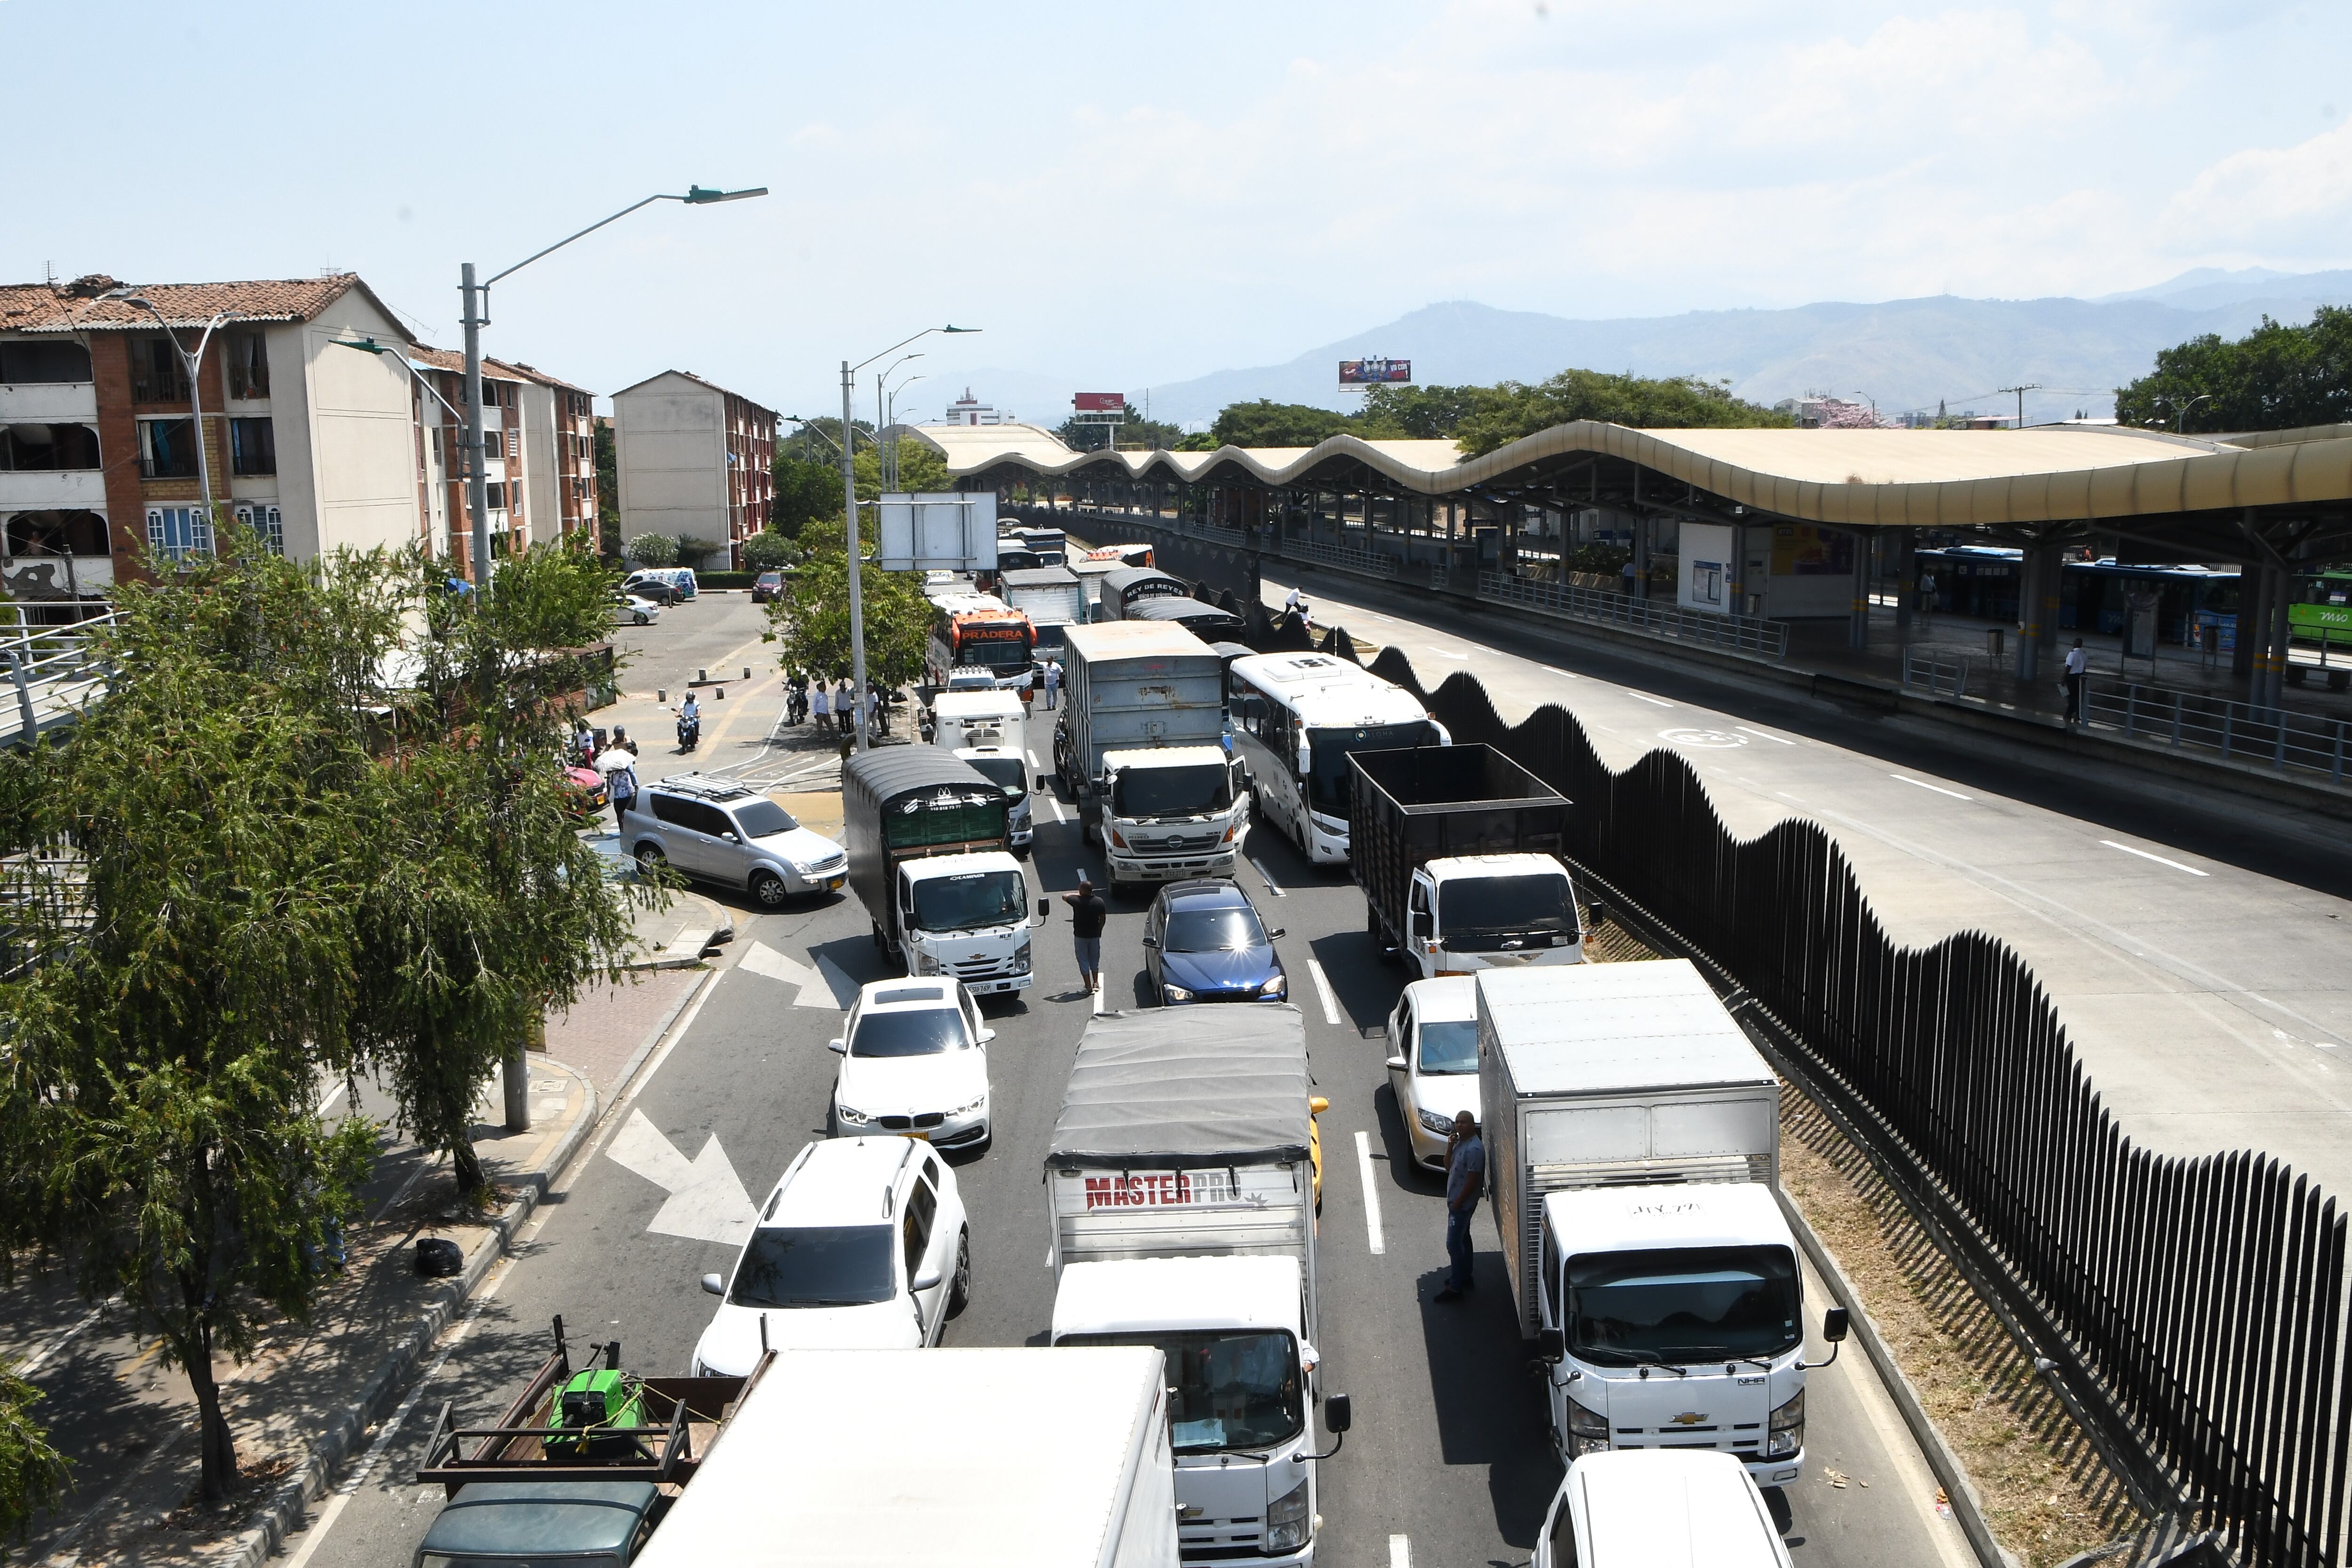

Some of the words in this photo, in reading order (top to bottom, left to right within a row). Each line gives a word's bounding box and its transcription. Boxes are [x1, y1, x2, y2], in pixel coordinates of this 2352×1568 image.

[1127, 586, 1142, 598] REY
[1157, 584, 1184, 596] REYES
[962, 630, 1024, 640] PRADERA
[1085, 1172, 1242, 1212] MASTERPRO
